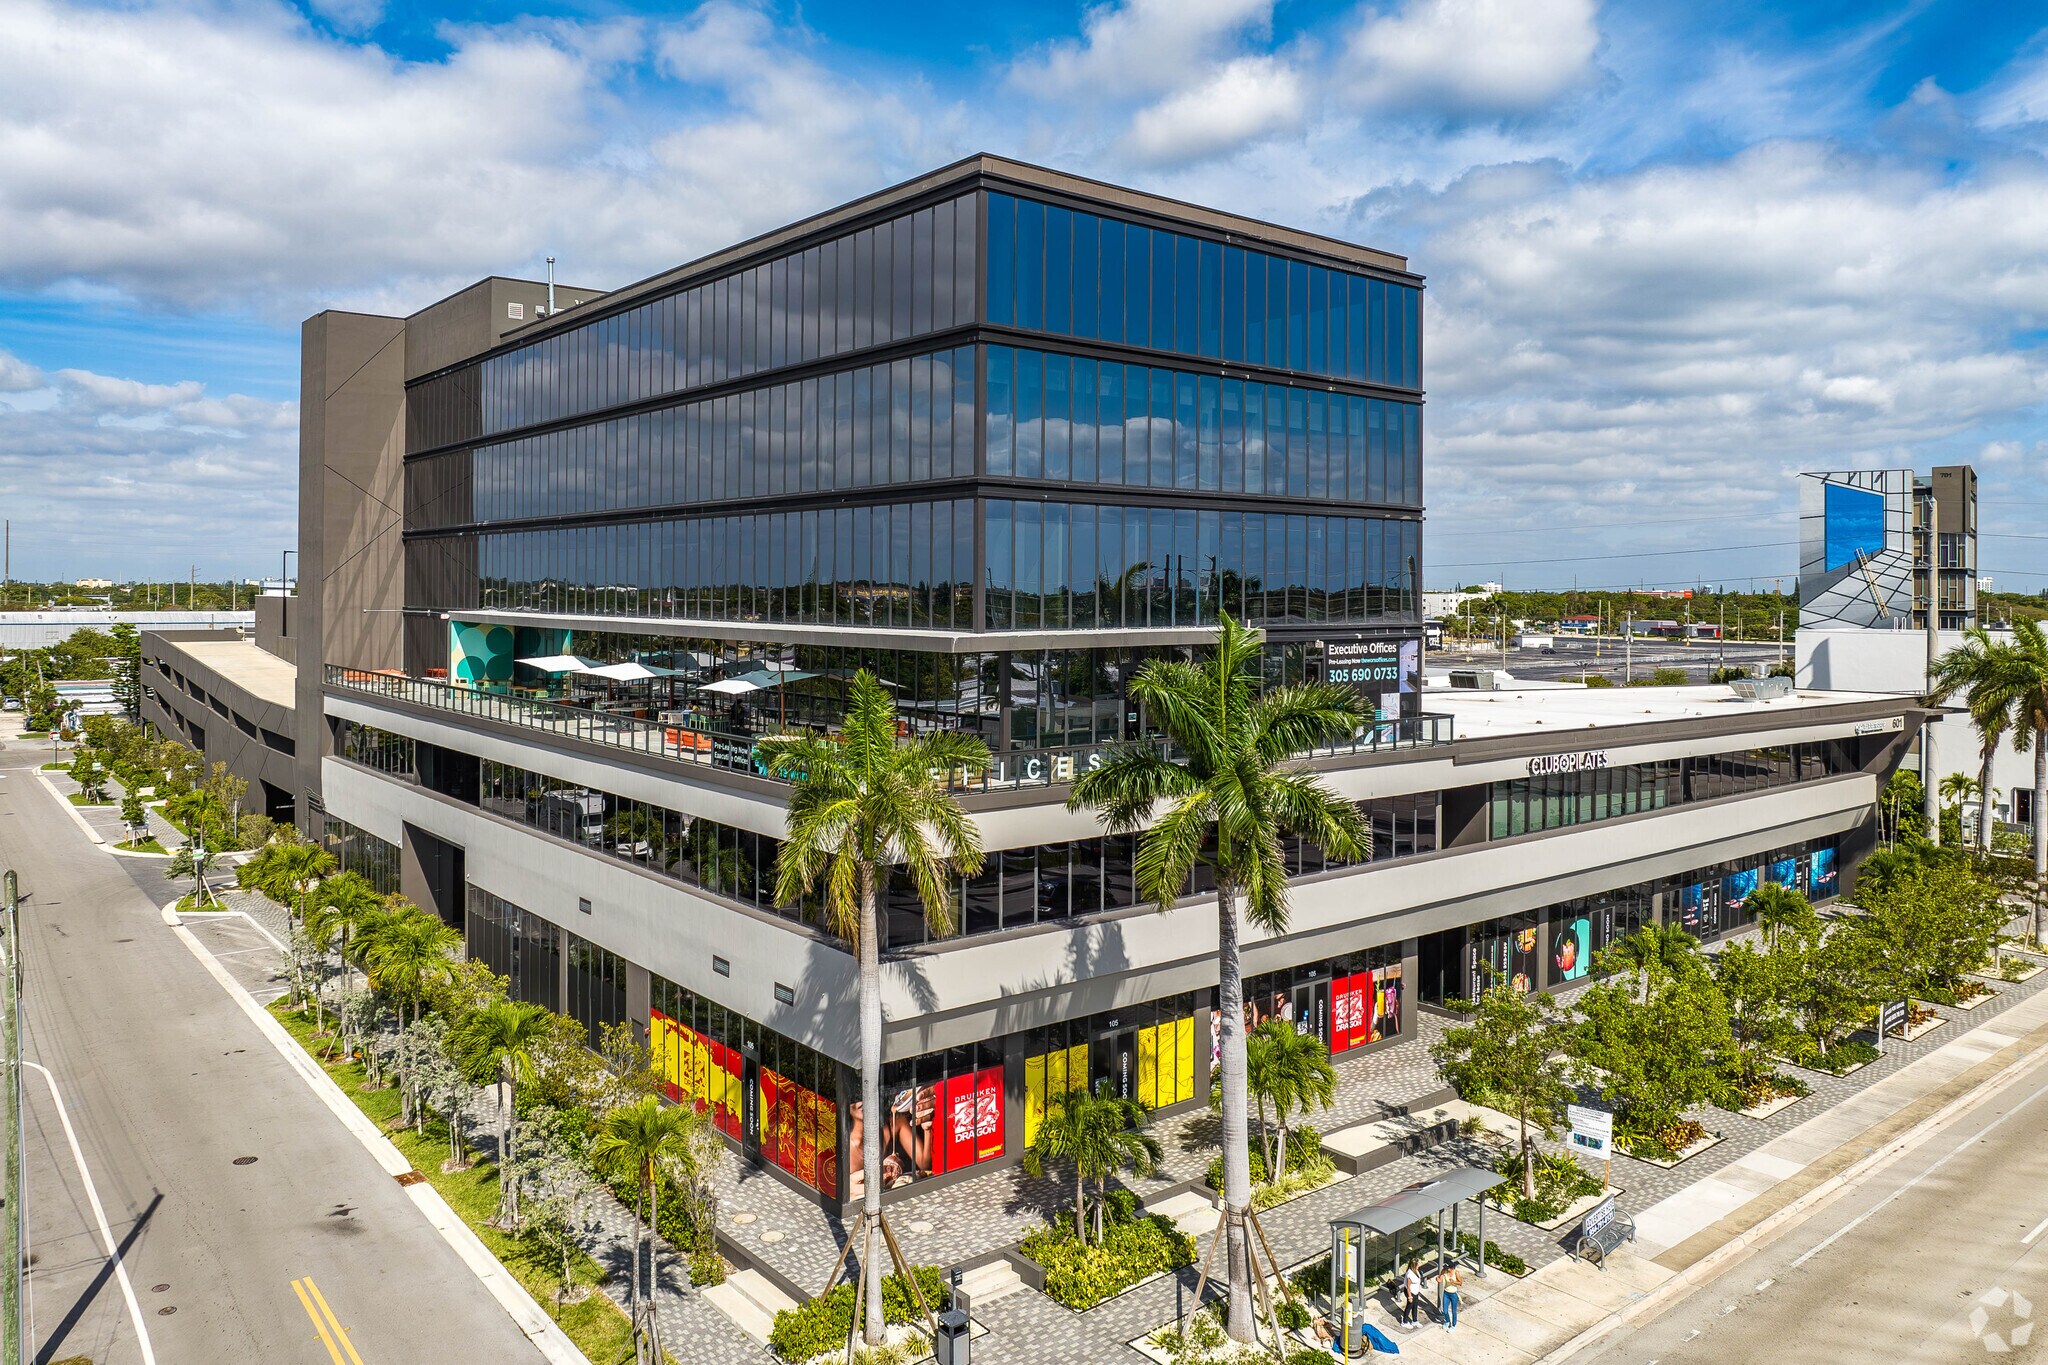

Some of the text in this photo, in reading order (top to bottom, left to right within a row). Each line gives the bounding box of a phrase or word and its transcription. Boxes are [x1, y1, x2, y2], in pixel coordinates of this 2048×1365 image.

[1328, 643, 1368, 655] Executive
[1369, 642, 1397, 654] Offices
[1329, 666, 1398, 683] 305 690 0733
[1892, 717, 1902, 729] 601
[714, 741, 749, 755] Pre-Leaing Now
[714, 751, 734, 762] Executie
[1531, 750, 1609, 775] CLUB PILATES
[955, 1124, 996, 1143] DRAGON
